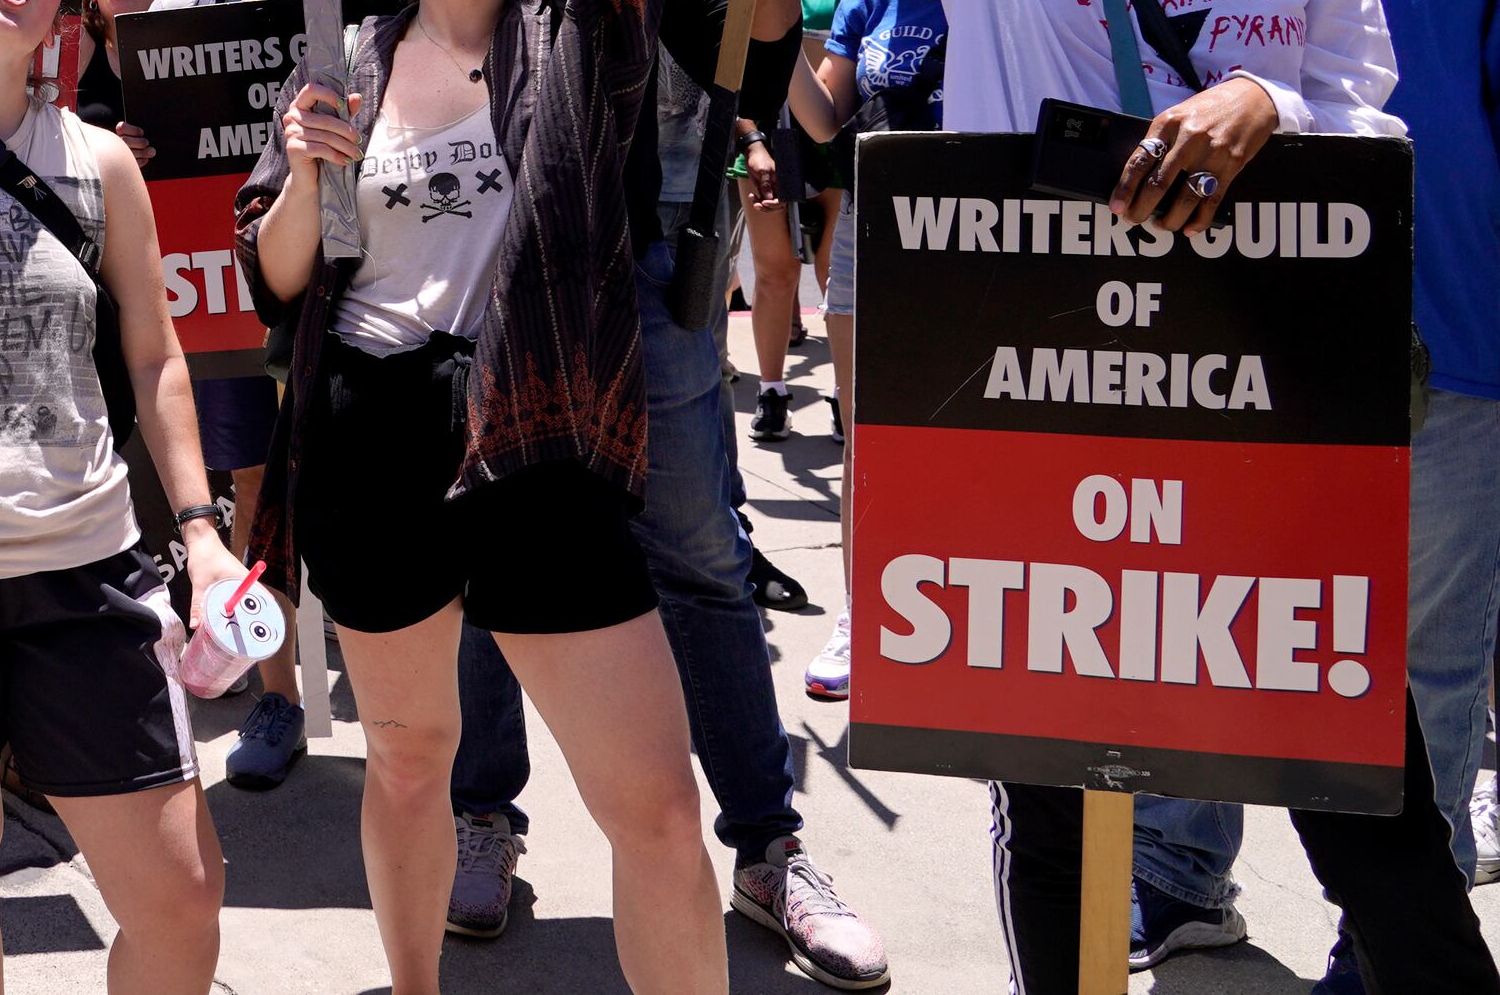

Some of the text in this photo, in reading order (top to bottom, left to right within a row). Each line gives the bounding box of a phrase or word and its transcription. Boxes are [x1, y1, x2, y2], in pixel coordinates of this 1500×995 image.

[137, 36, 283, 80] WRITERS
[879, 25, 933, 41] GUILD
[360, 150, 438, 181] Derby
[893, 196, 1371, 260] WRITERS GUILD
[1096, 281, 1162, 328] OF
[983, 346, 1272, 411] AMERICA
[1071, 473, 1184, 546] ON
[879, 553, 1371, 698] STRIKE!
